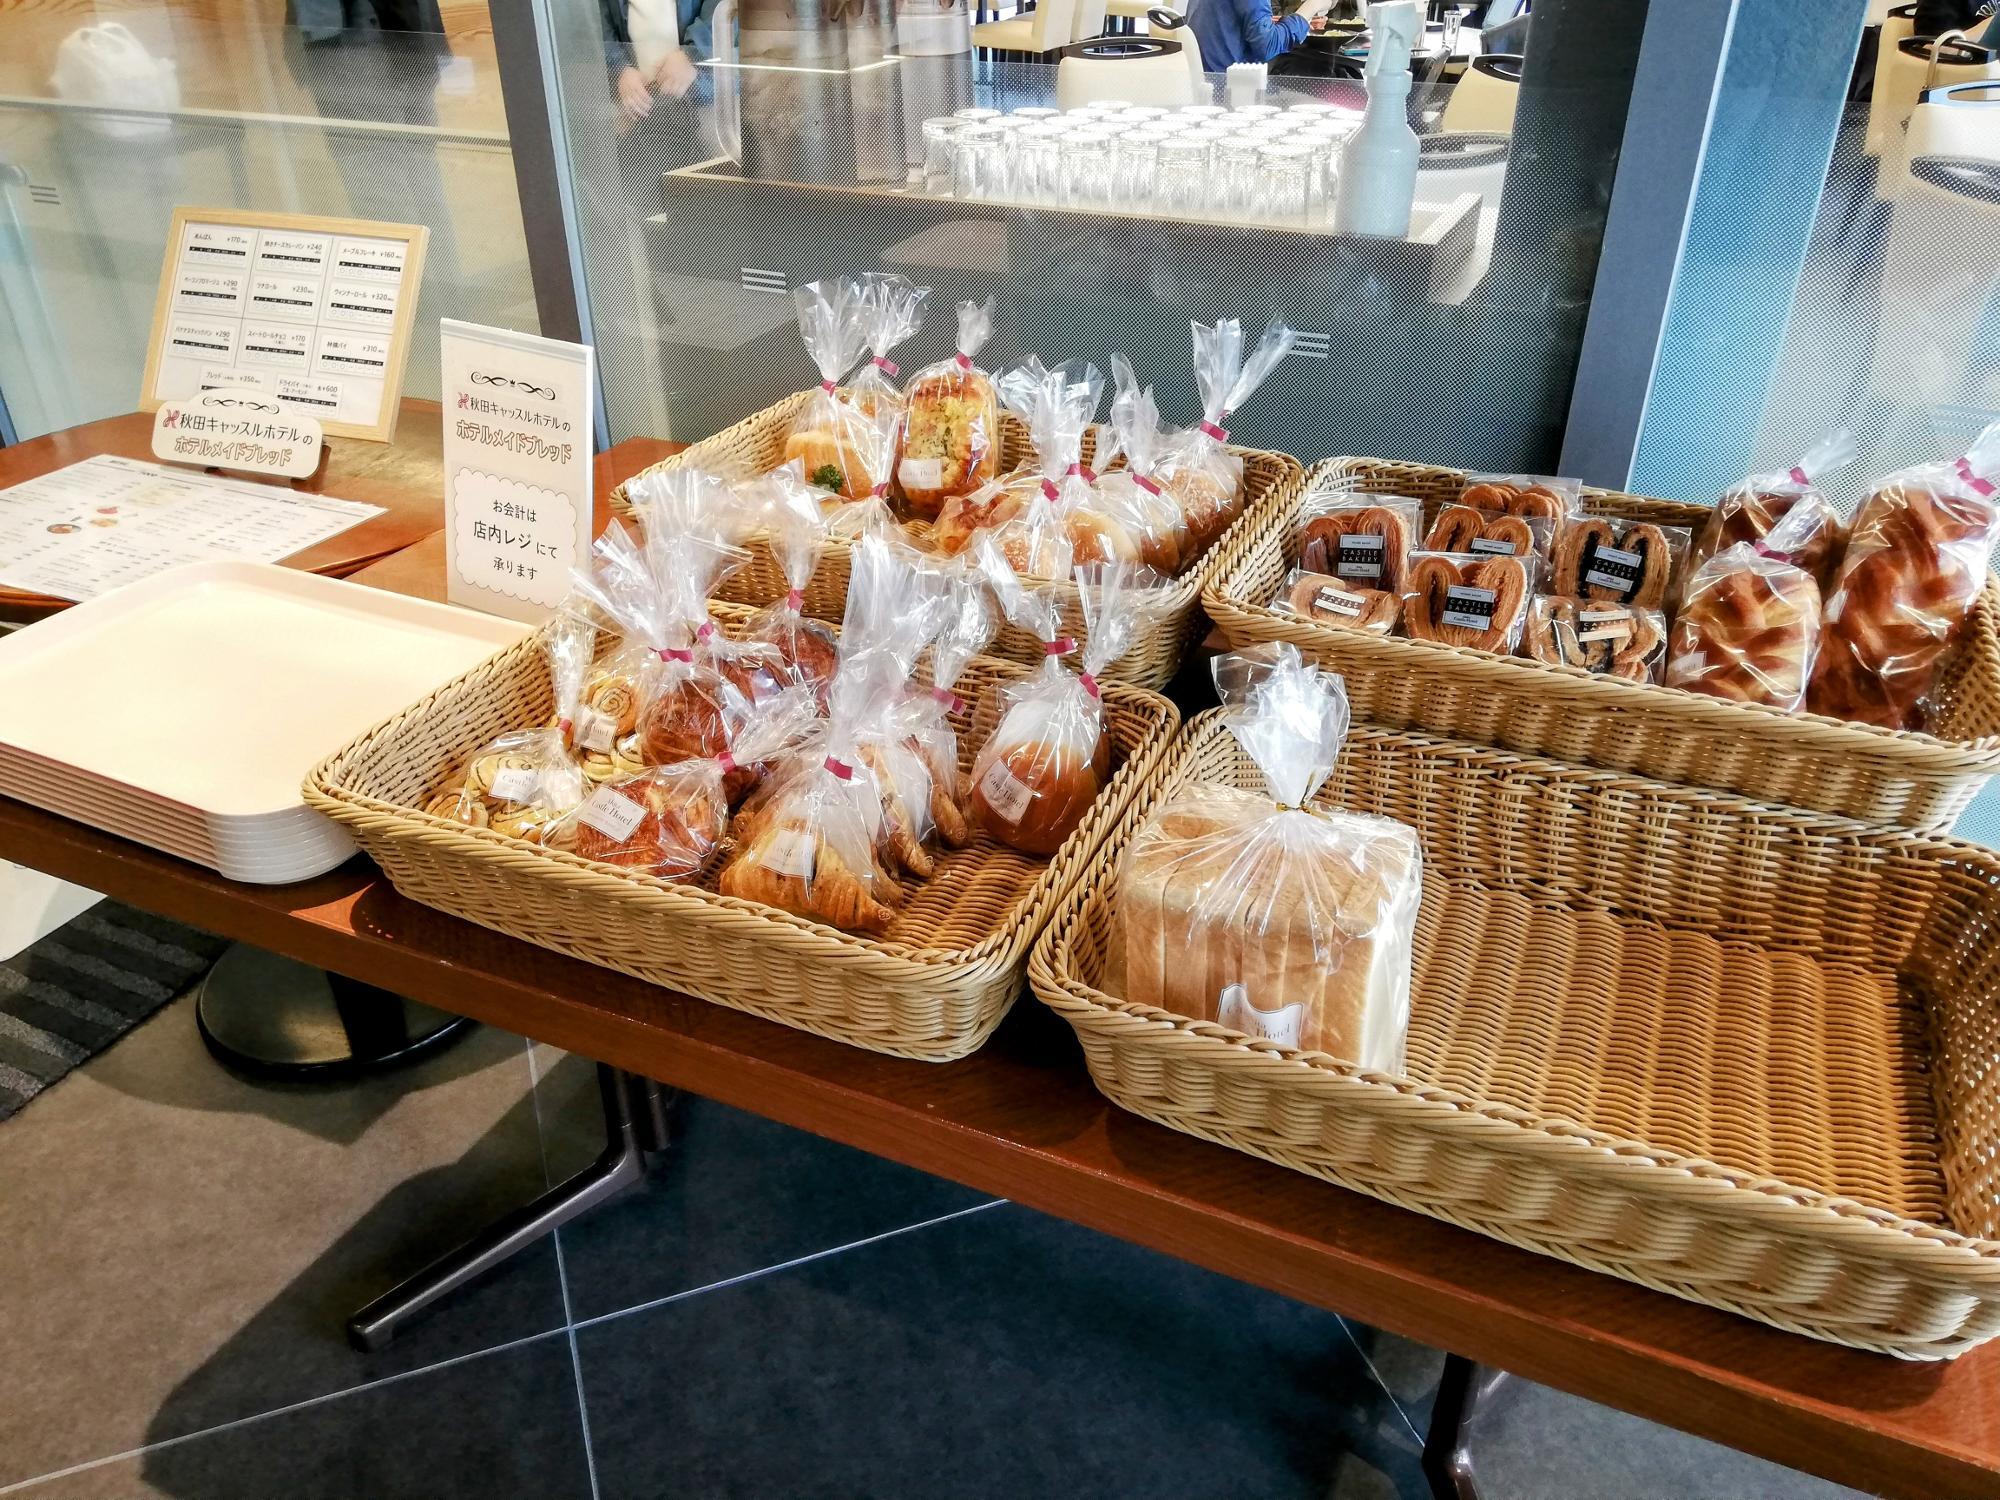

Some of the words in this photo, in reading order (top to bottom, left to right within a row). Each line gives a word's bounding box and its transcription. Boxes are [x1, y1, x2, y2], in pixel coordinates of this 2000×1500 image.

[470, 396, 571, 433] 秋田キャッスルホテルの
[179, 412, 313, 446] 秋田キャッスルホテルの
[174, 436, 293, 467] ホテルメイドブレッド
[456, 419, 572, 465] ホテルメイドブレッド
[492, 499, 537, 523] お会計は
[493, 556, 538, 581] 承ります
[1594, 565, 1632, 578] BAKERY
[1596, 559, 1633, 573] CASTLE
[1449, 605, 1488, 614] BAKERY
[1450, 599, 1488, 608] CASTLE
